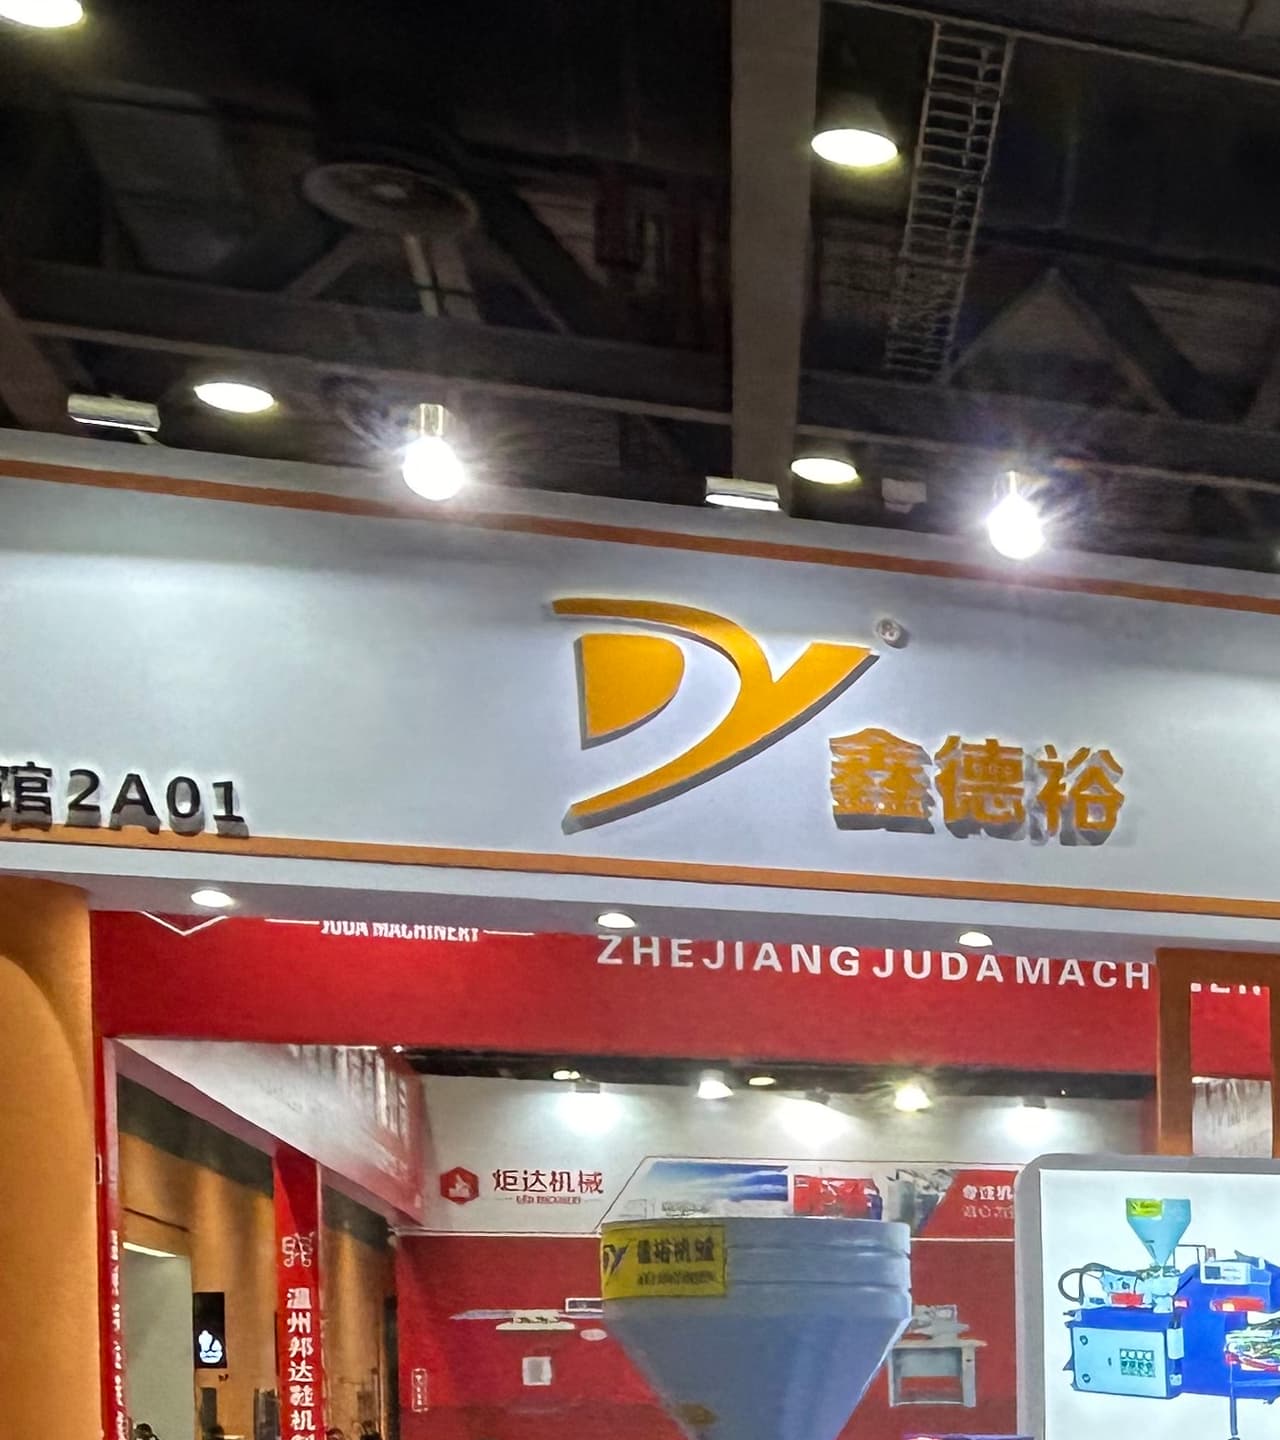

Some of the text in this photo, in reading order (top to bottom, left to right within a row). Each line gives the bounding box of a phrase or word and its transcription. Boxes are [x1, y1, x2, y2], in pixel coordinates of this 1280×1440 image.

[829, 728, 1125, 845] 鑫德裕
[598, 934, 860, 978] ZHEJIANG
[873, 948, 1004, 984] JUDA
[1016, 956, 1150, 990] MACH
